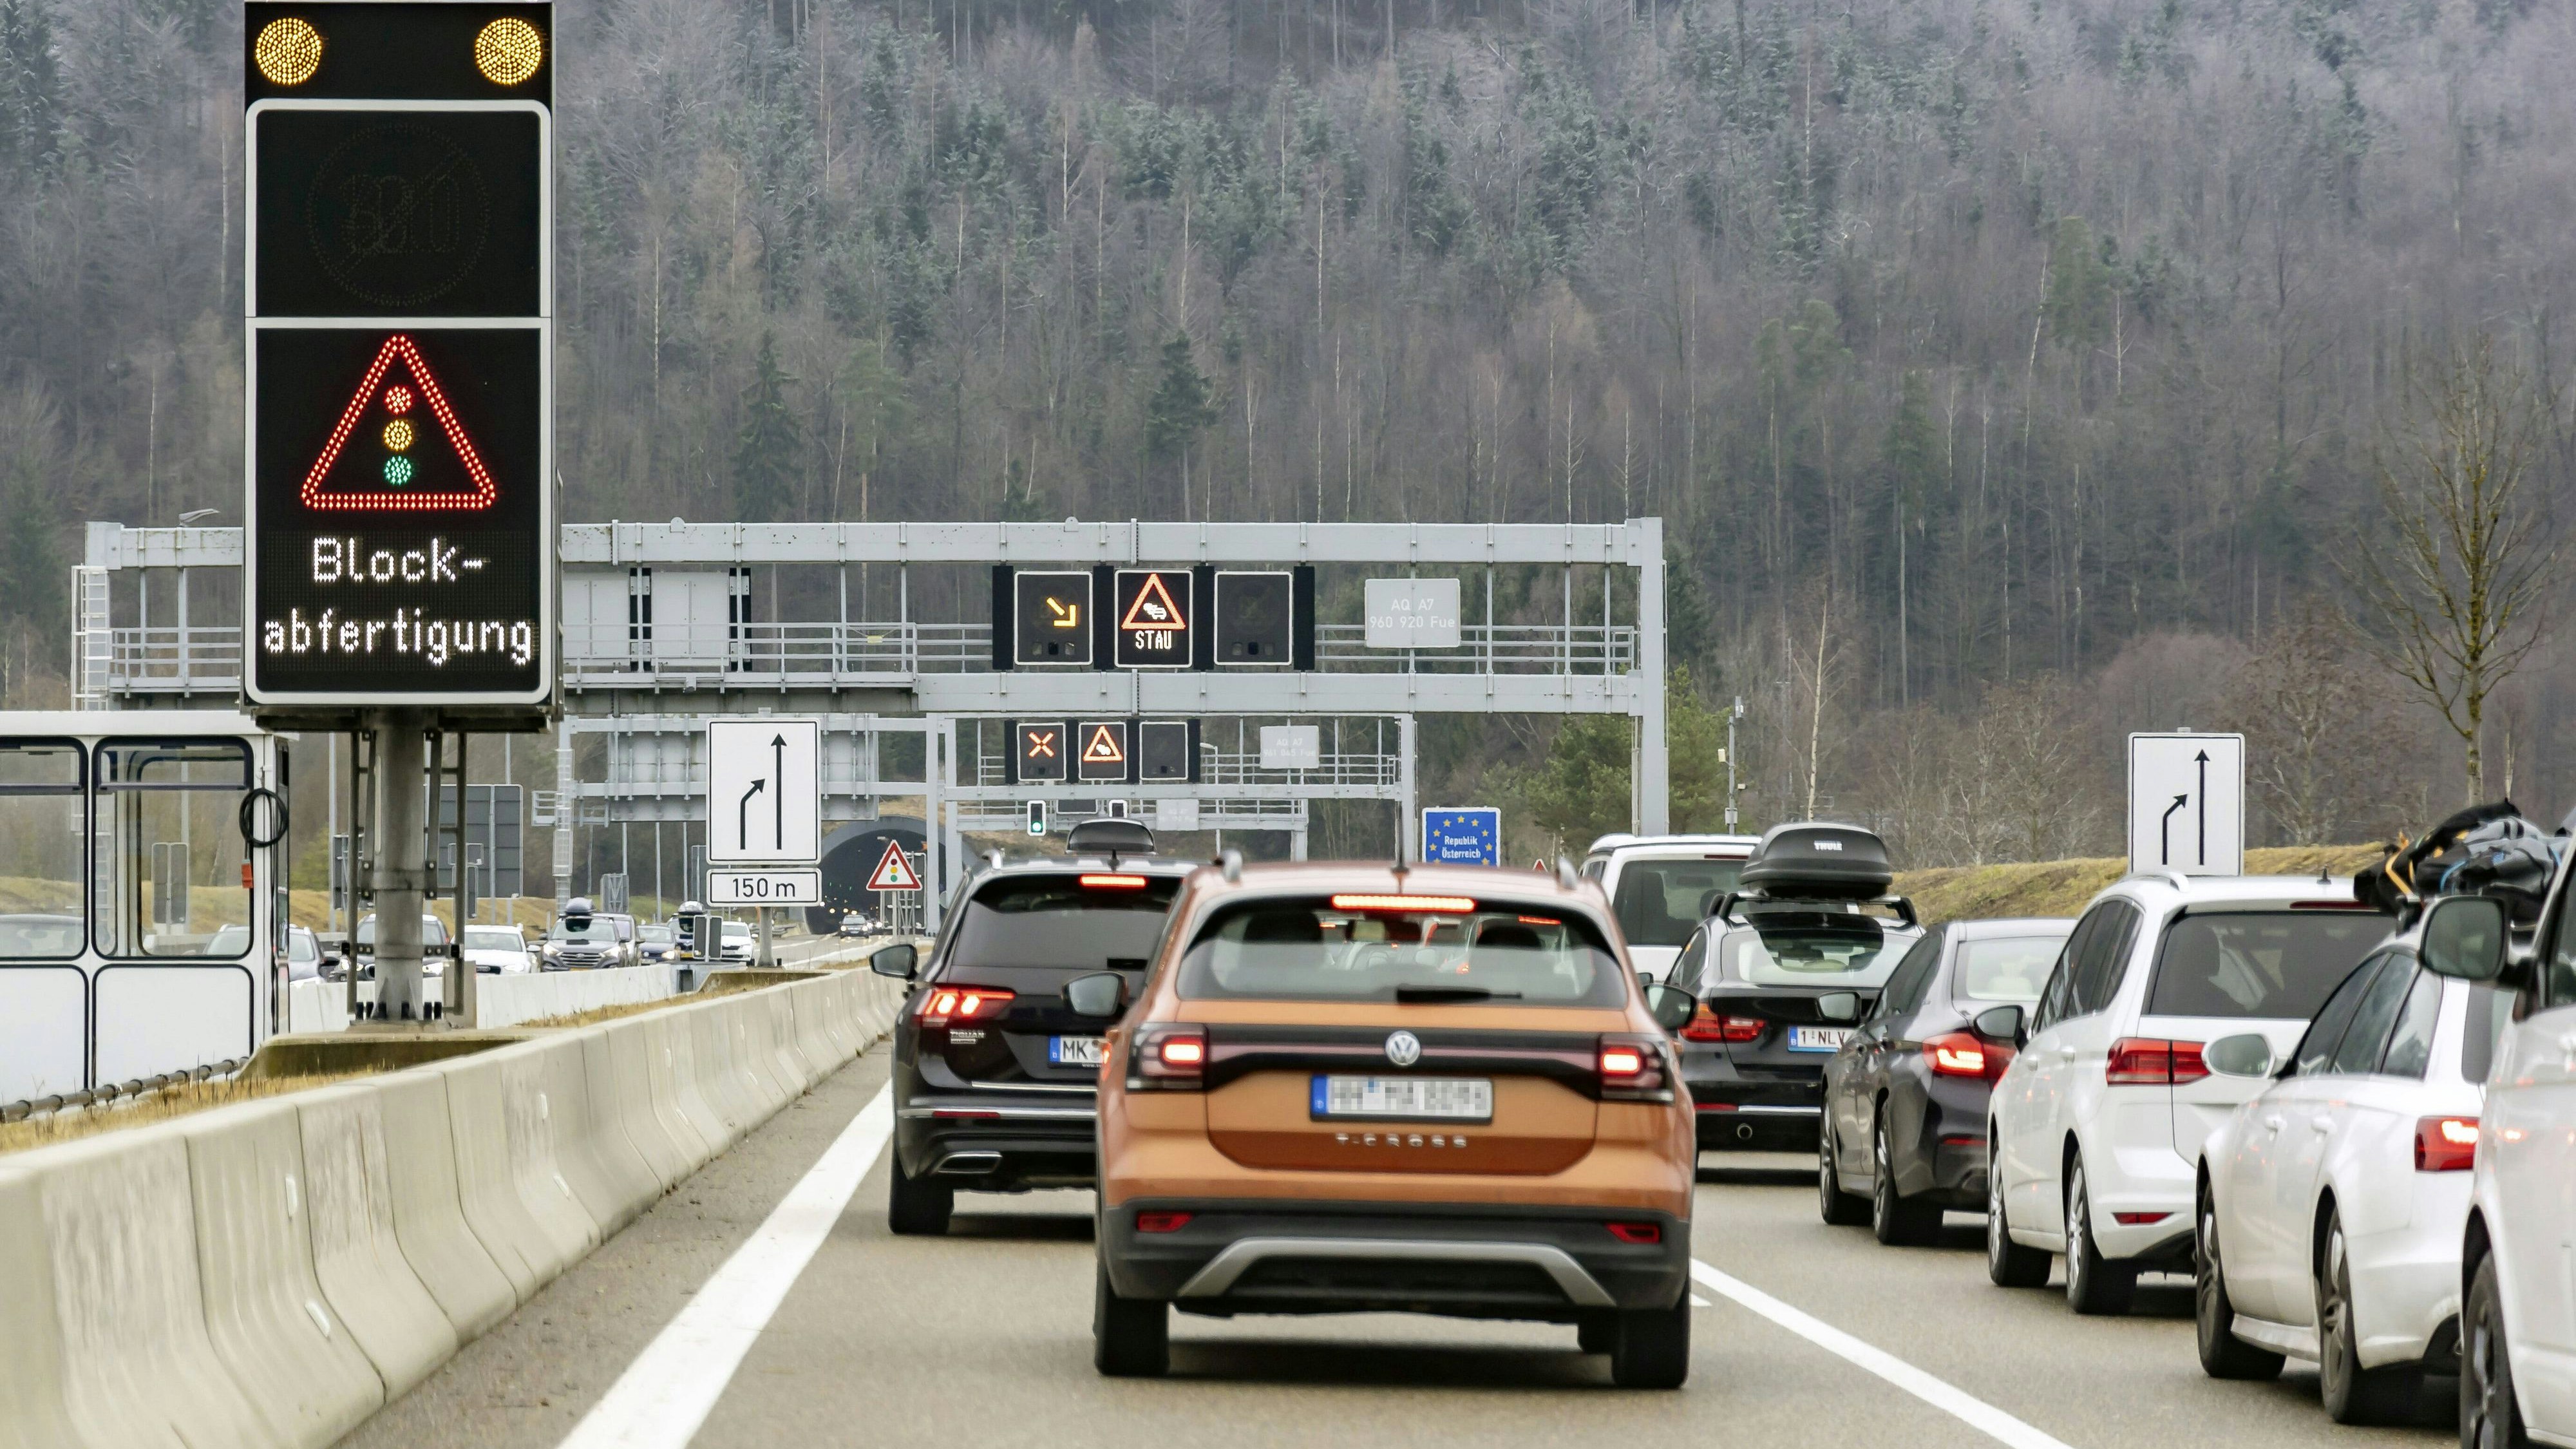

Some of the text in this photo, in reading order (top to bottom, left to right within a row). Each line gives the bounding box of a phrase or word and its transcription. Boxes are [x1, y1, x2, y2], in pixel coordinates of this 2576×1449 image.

[313, 537, 483, 582] Block-
[1391, 598, 1434, 611] AQ A7
[1370, 616, 1455, 628] 960 920 Fue
[265, 607, 532, 665] abfertigung
[1135, 630, 1172, 650] STAU
[1444, 835, 1478, 848] Republik
[1814, 840, 1842, 851] THULE
[1442, 846, 1481, 858] Österreich
[733, 878, 795, 898] 150 m
[1063, 1040, 1088, 1060] MK
